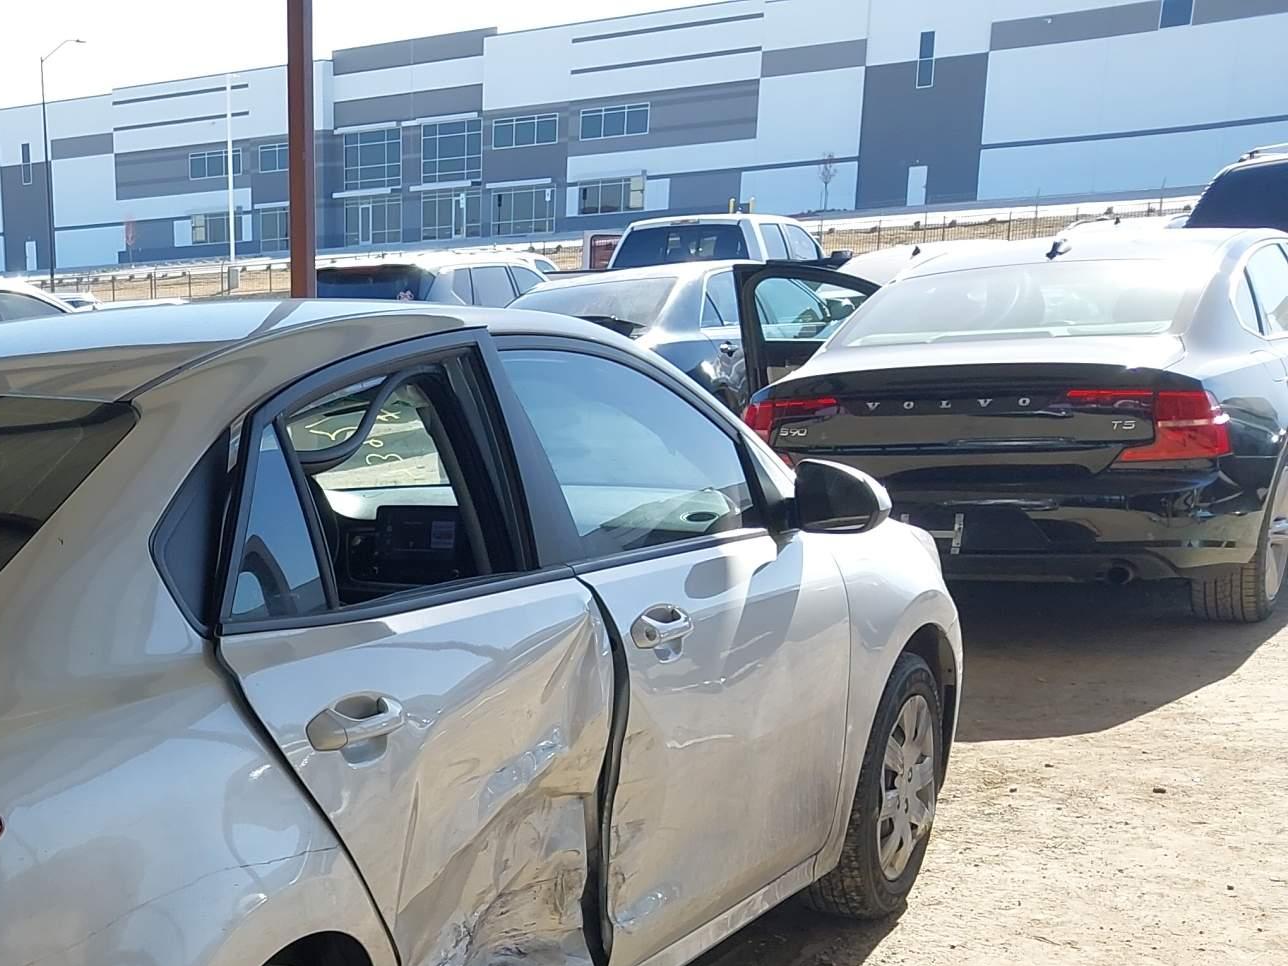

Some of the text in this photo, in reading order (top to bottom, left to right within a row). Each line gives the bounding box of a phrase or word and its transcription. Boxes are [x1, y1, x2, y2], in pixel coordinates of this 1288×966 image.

[866, 397, 1031, 411] VOLVO
[1111, 420, 1136, 430] T5
[779, 427, 808, 437] S90
